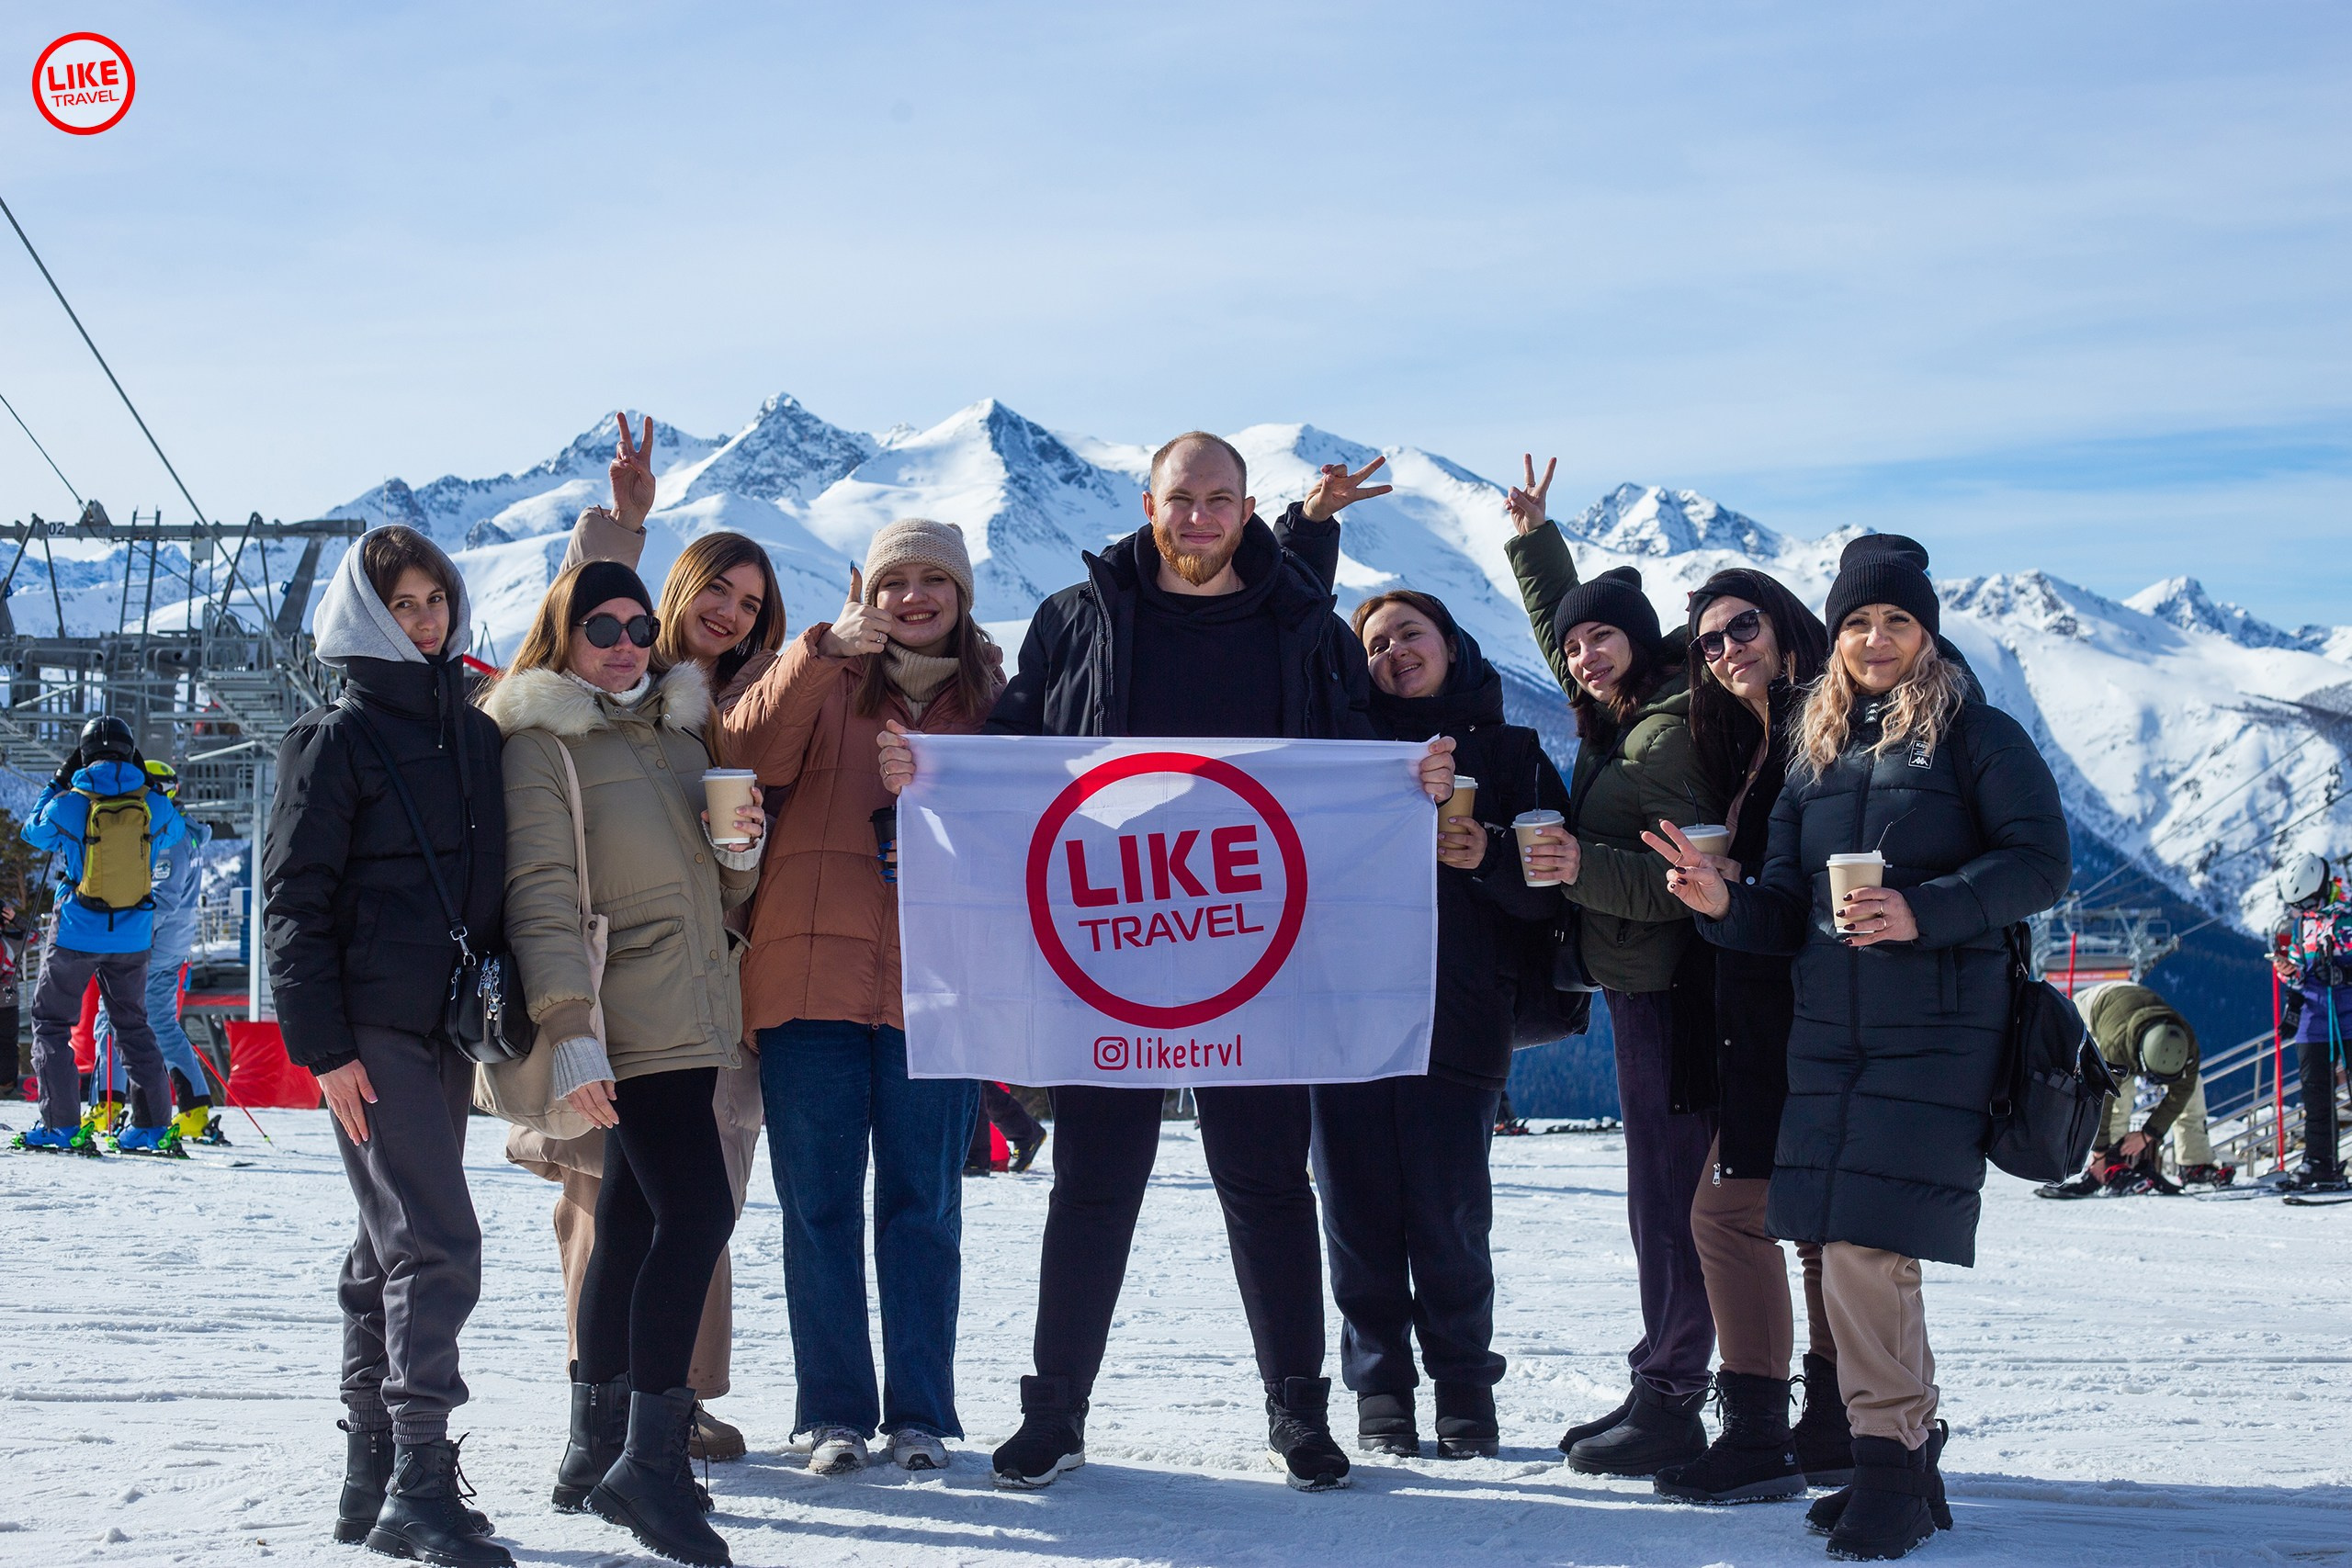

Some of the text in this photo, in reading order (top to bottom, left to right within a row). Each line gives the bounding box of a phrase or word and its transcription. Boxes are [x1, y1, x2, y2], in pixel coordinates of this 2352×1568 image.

[48, 522, 65, 536] 02
[1065, 824, 1262, 908] LIKE
[1078, 903, 1264, 952] TRAVEL
[1136, 1033, 1243, 1070] liketrvl
